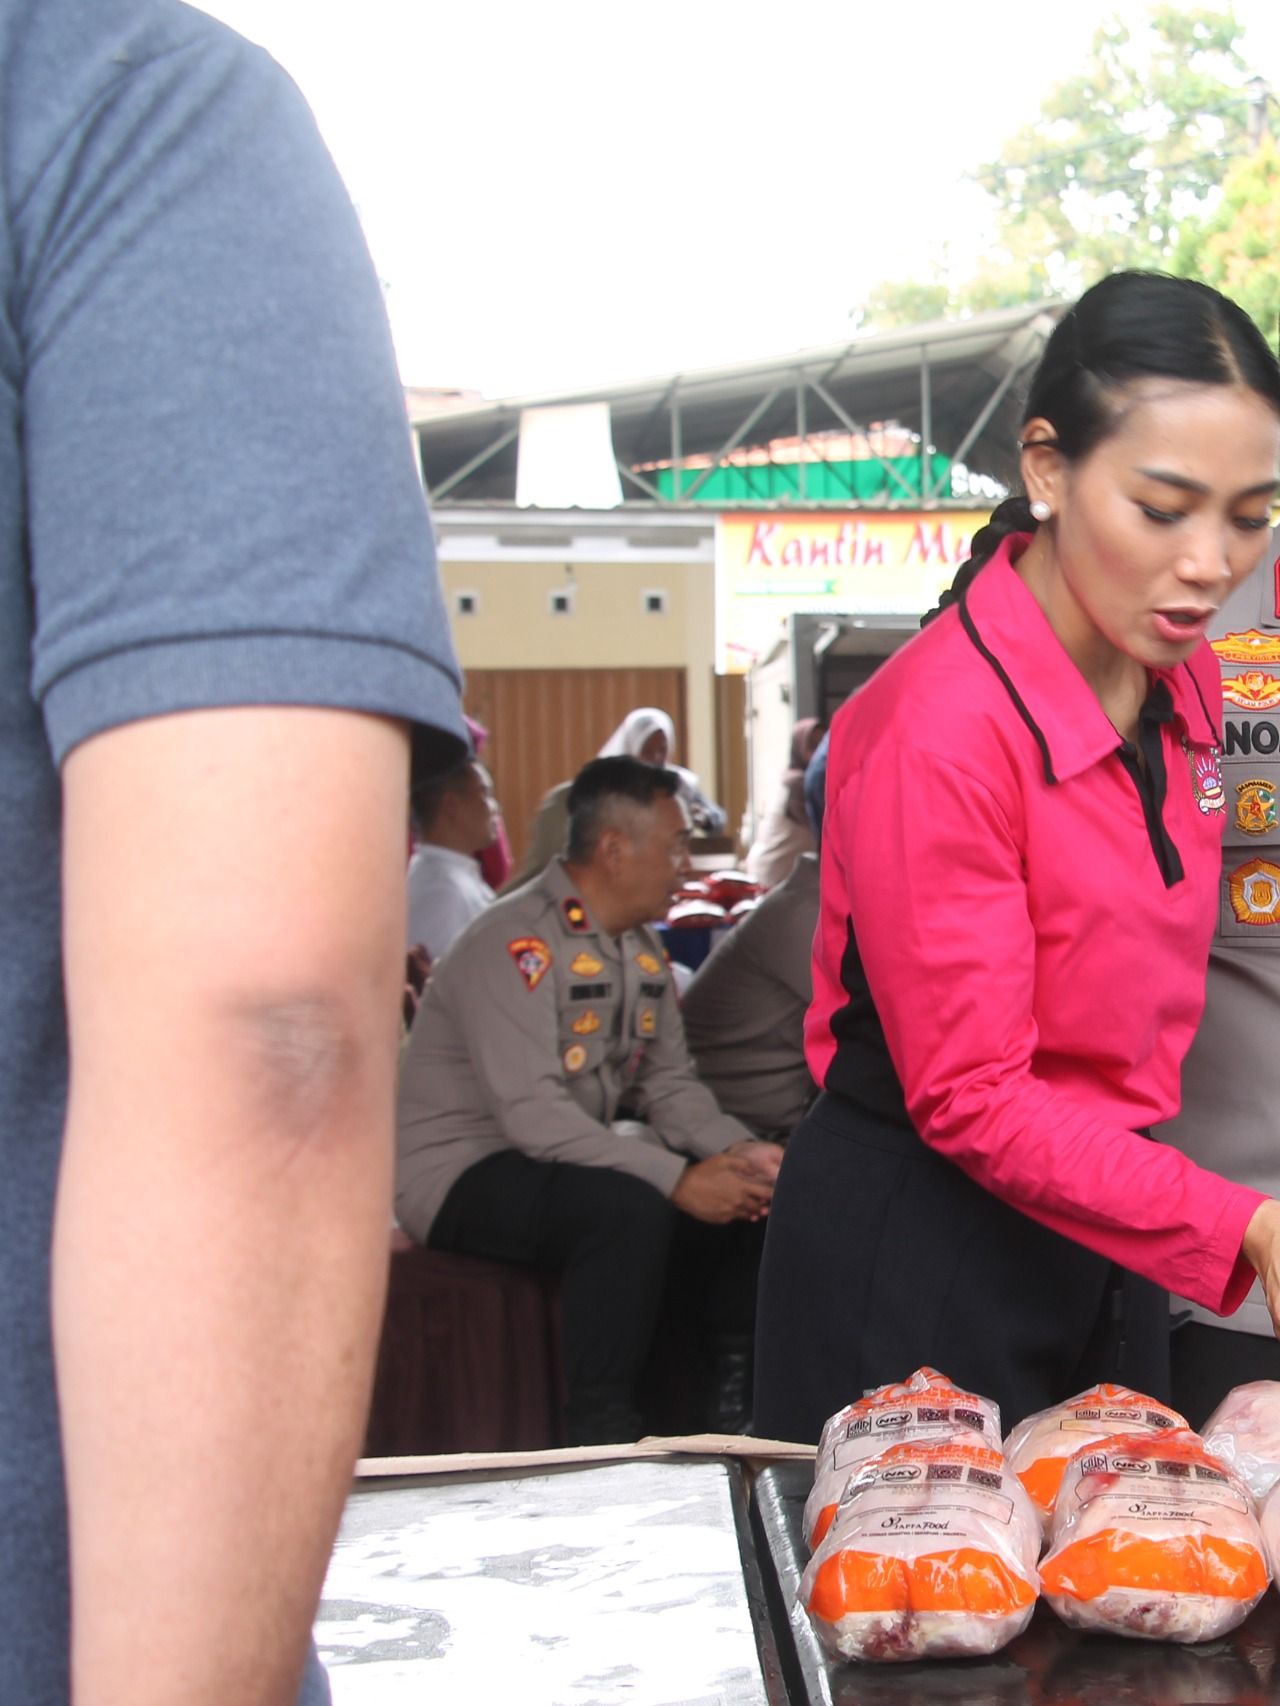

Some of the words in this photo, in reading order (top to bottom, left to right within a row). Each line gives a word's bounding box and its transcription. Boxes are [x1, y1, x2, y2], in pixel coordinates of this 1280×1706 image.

[747, 520, 885, 566] Kantin
[1107, 1410, 1139, 1419] NKV
[878, 1414, 910, 1425] NKV
[1115, 1461, 1148, 1470] NKV
[885, 1469, 918, 1478] NKV
